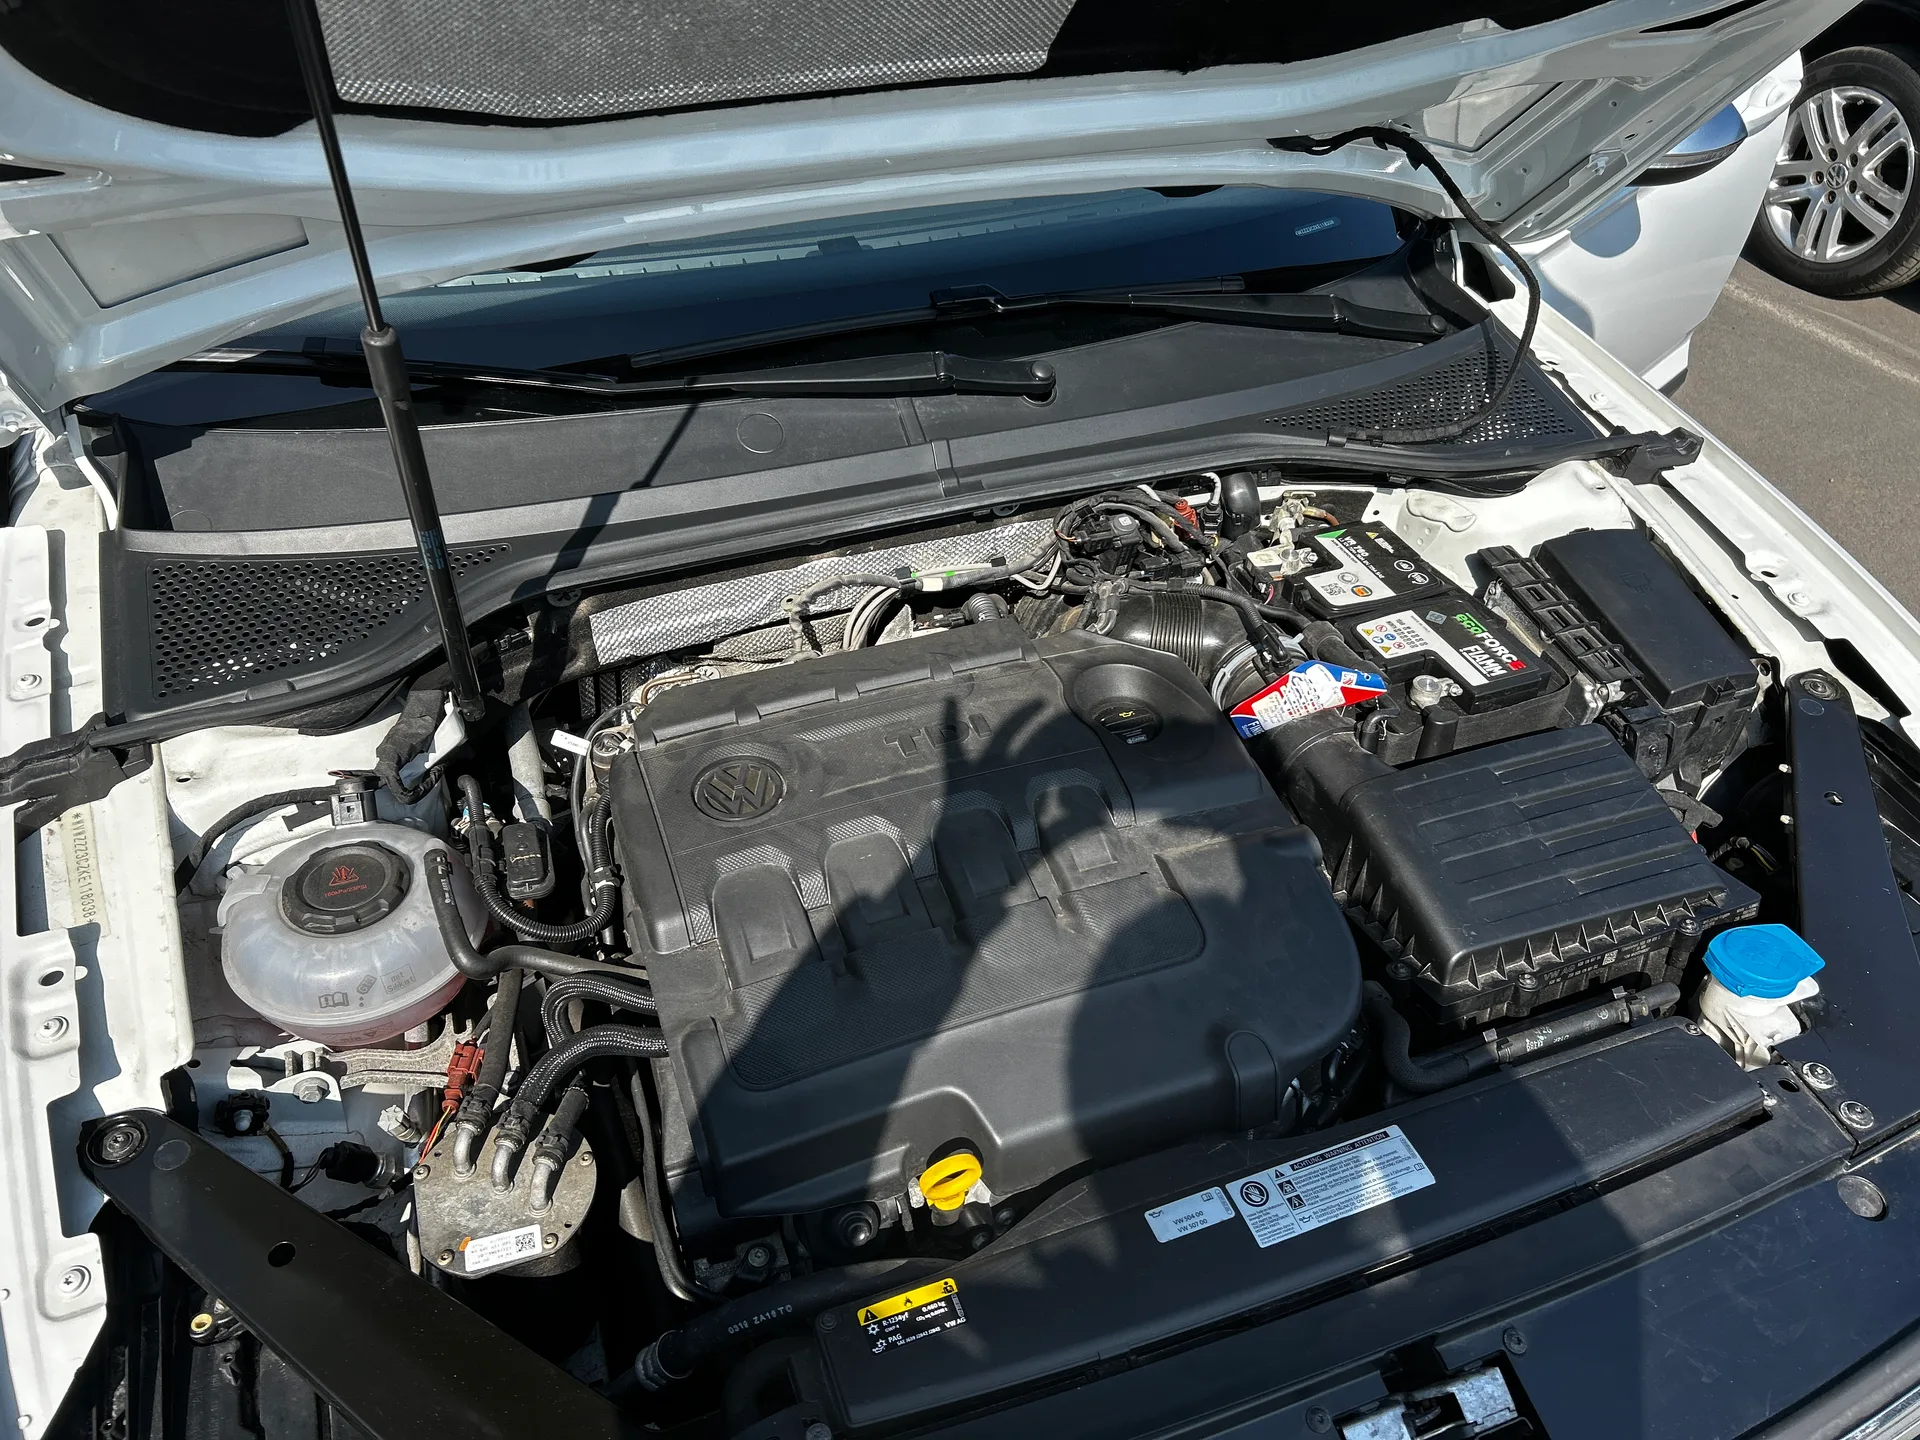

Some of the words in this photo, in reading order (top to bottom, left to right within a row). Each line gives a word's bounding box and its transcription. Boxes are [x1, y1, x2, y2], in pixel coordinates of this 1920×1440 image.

[1455, 613, 1527, 672] ecoFORCE
[1463, 644, 1508, 678] FIAMM
[884, 713, 993, 758] TDI
[386, 976, 415, 993] Silikat
[390, 970, 404, 982] mit
[1292, 1155, 1322, 1169] ACHTUNG
[1322, 1144, 1353, 1158] WARNING
[1353, 1132, 1386, 1147] ATTENTION
[882, 1312, 909, 1326] R-1234yf
[944, 1320, 956, 1328] VW
[888, 1334, 902, 1343] PAG
